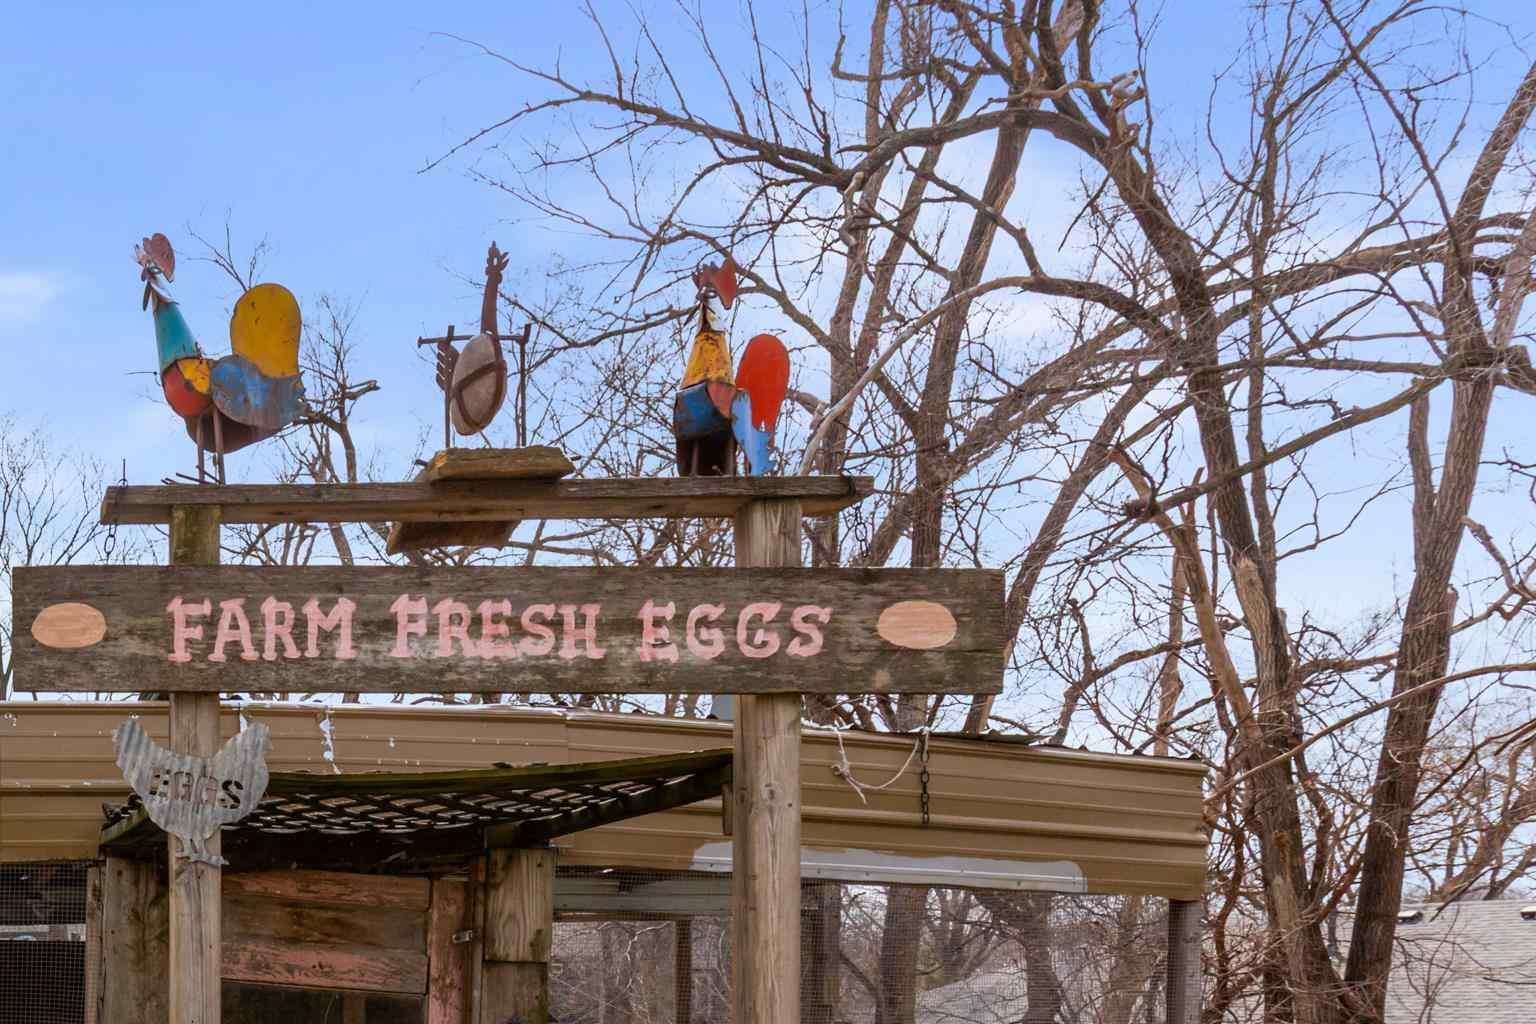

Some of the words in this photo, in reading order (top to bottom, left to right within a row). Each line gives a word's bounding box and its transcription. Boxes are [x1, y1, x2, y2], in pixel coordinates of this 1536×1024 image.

[166, 594, 358, 663] FARM
[389, 593, 606, 660] FRESH
[636, 598, 833, 662] EGGS
